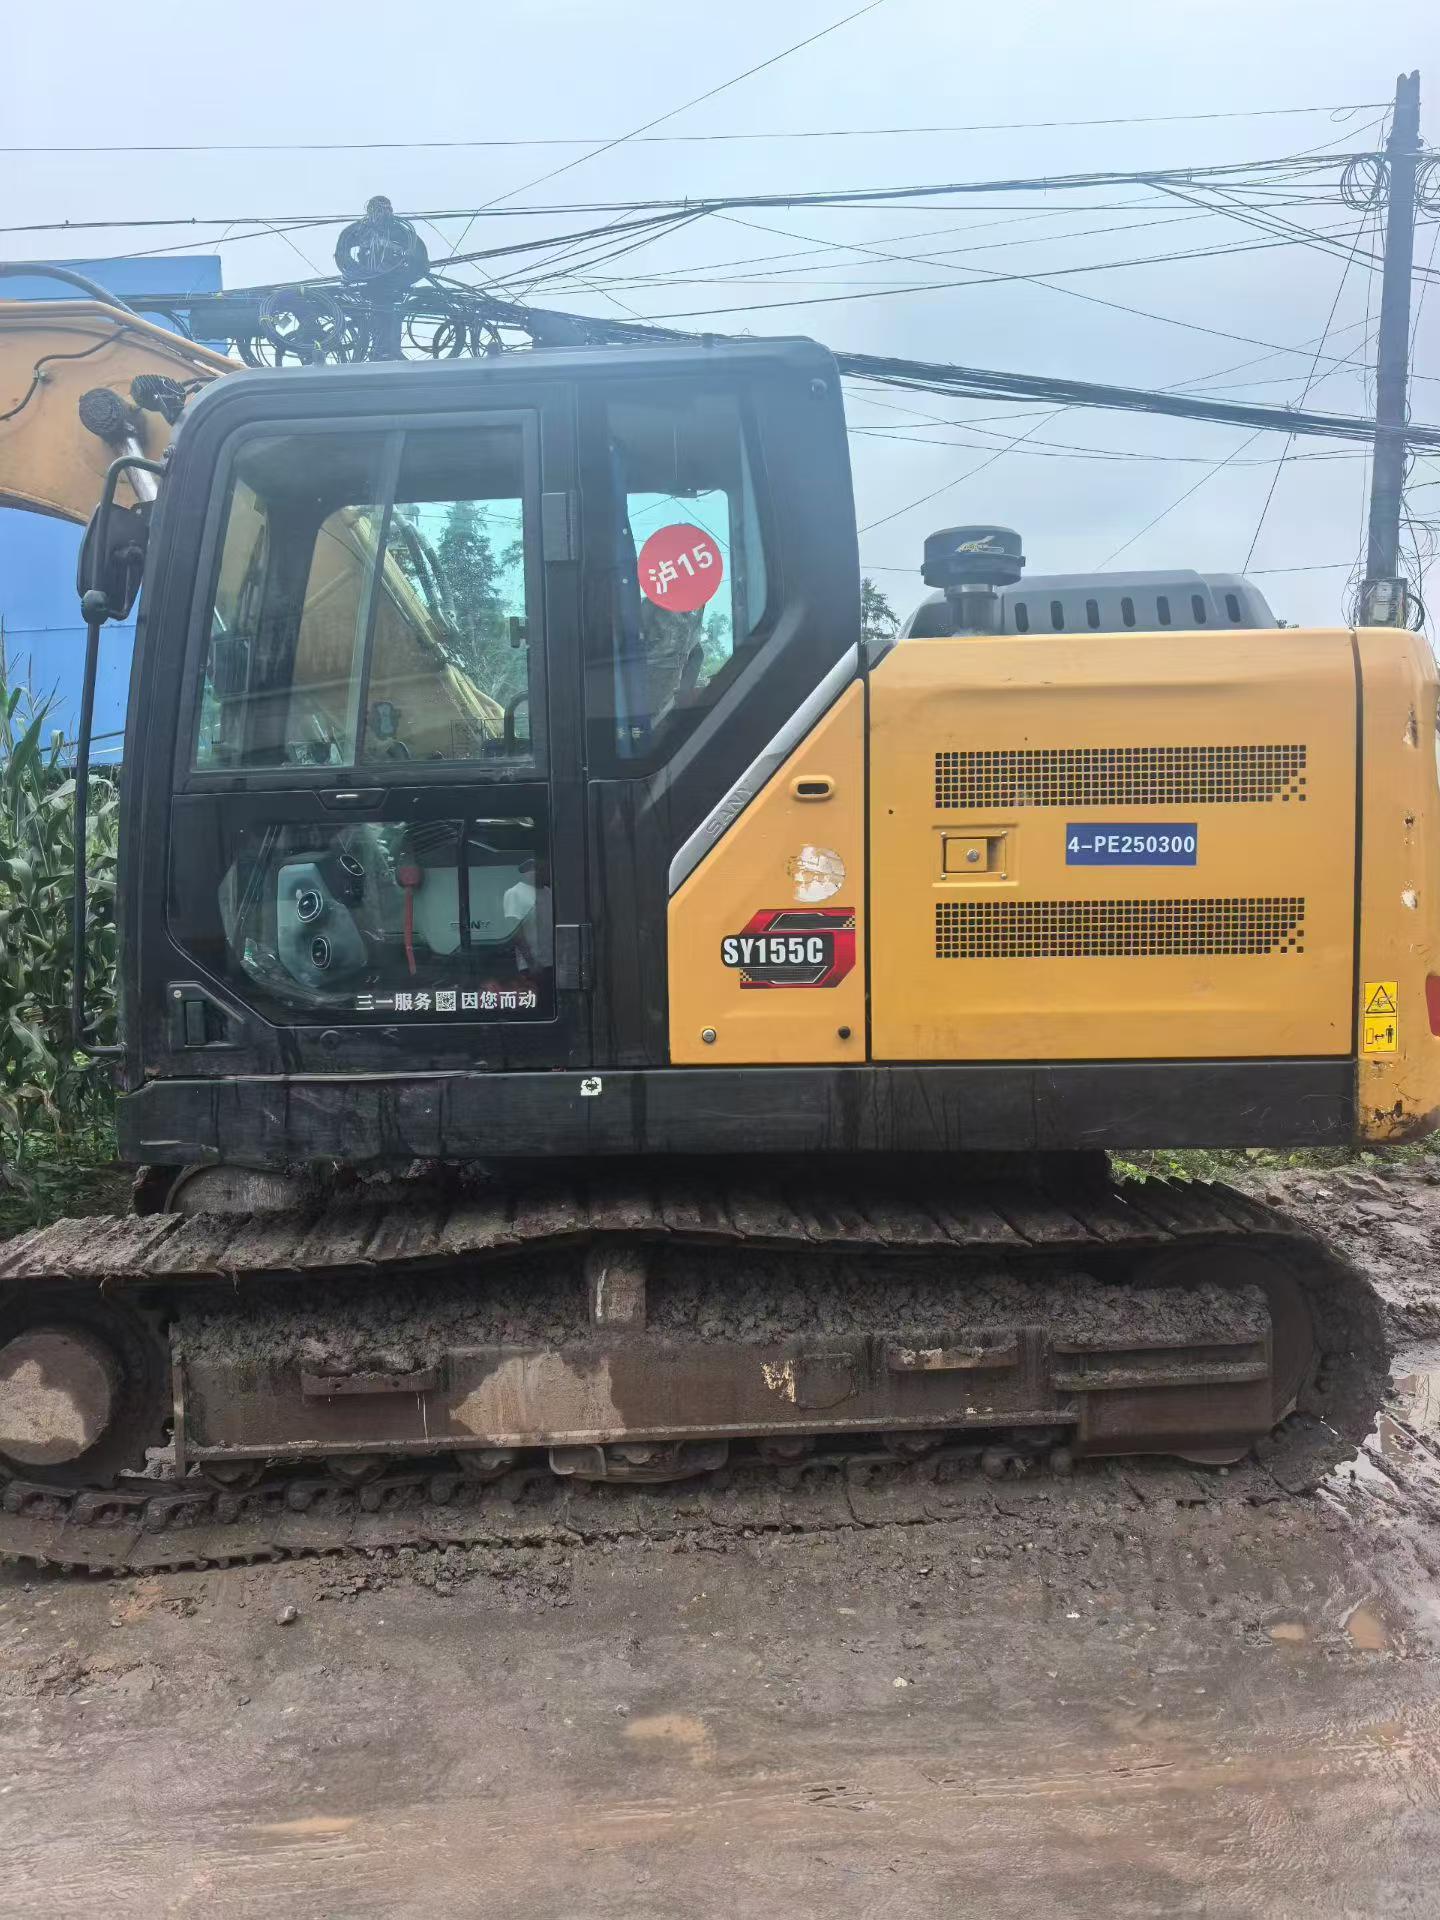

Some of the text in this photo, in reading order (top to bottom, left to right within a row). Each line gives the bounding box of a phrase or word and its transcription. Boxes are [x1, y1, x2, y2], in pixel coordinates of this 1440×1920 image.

[648, 542, 713, 594] 泸15
[705, 780, 755, 838] SANY
[1067, 835, 1196, 853] 4-PE250300
[723, 937, 823, 964] SY155C
[355, 990, 537, 1011] 三一服务 因您而动
